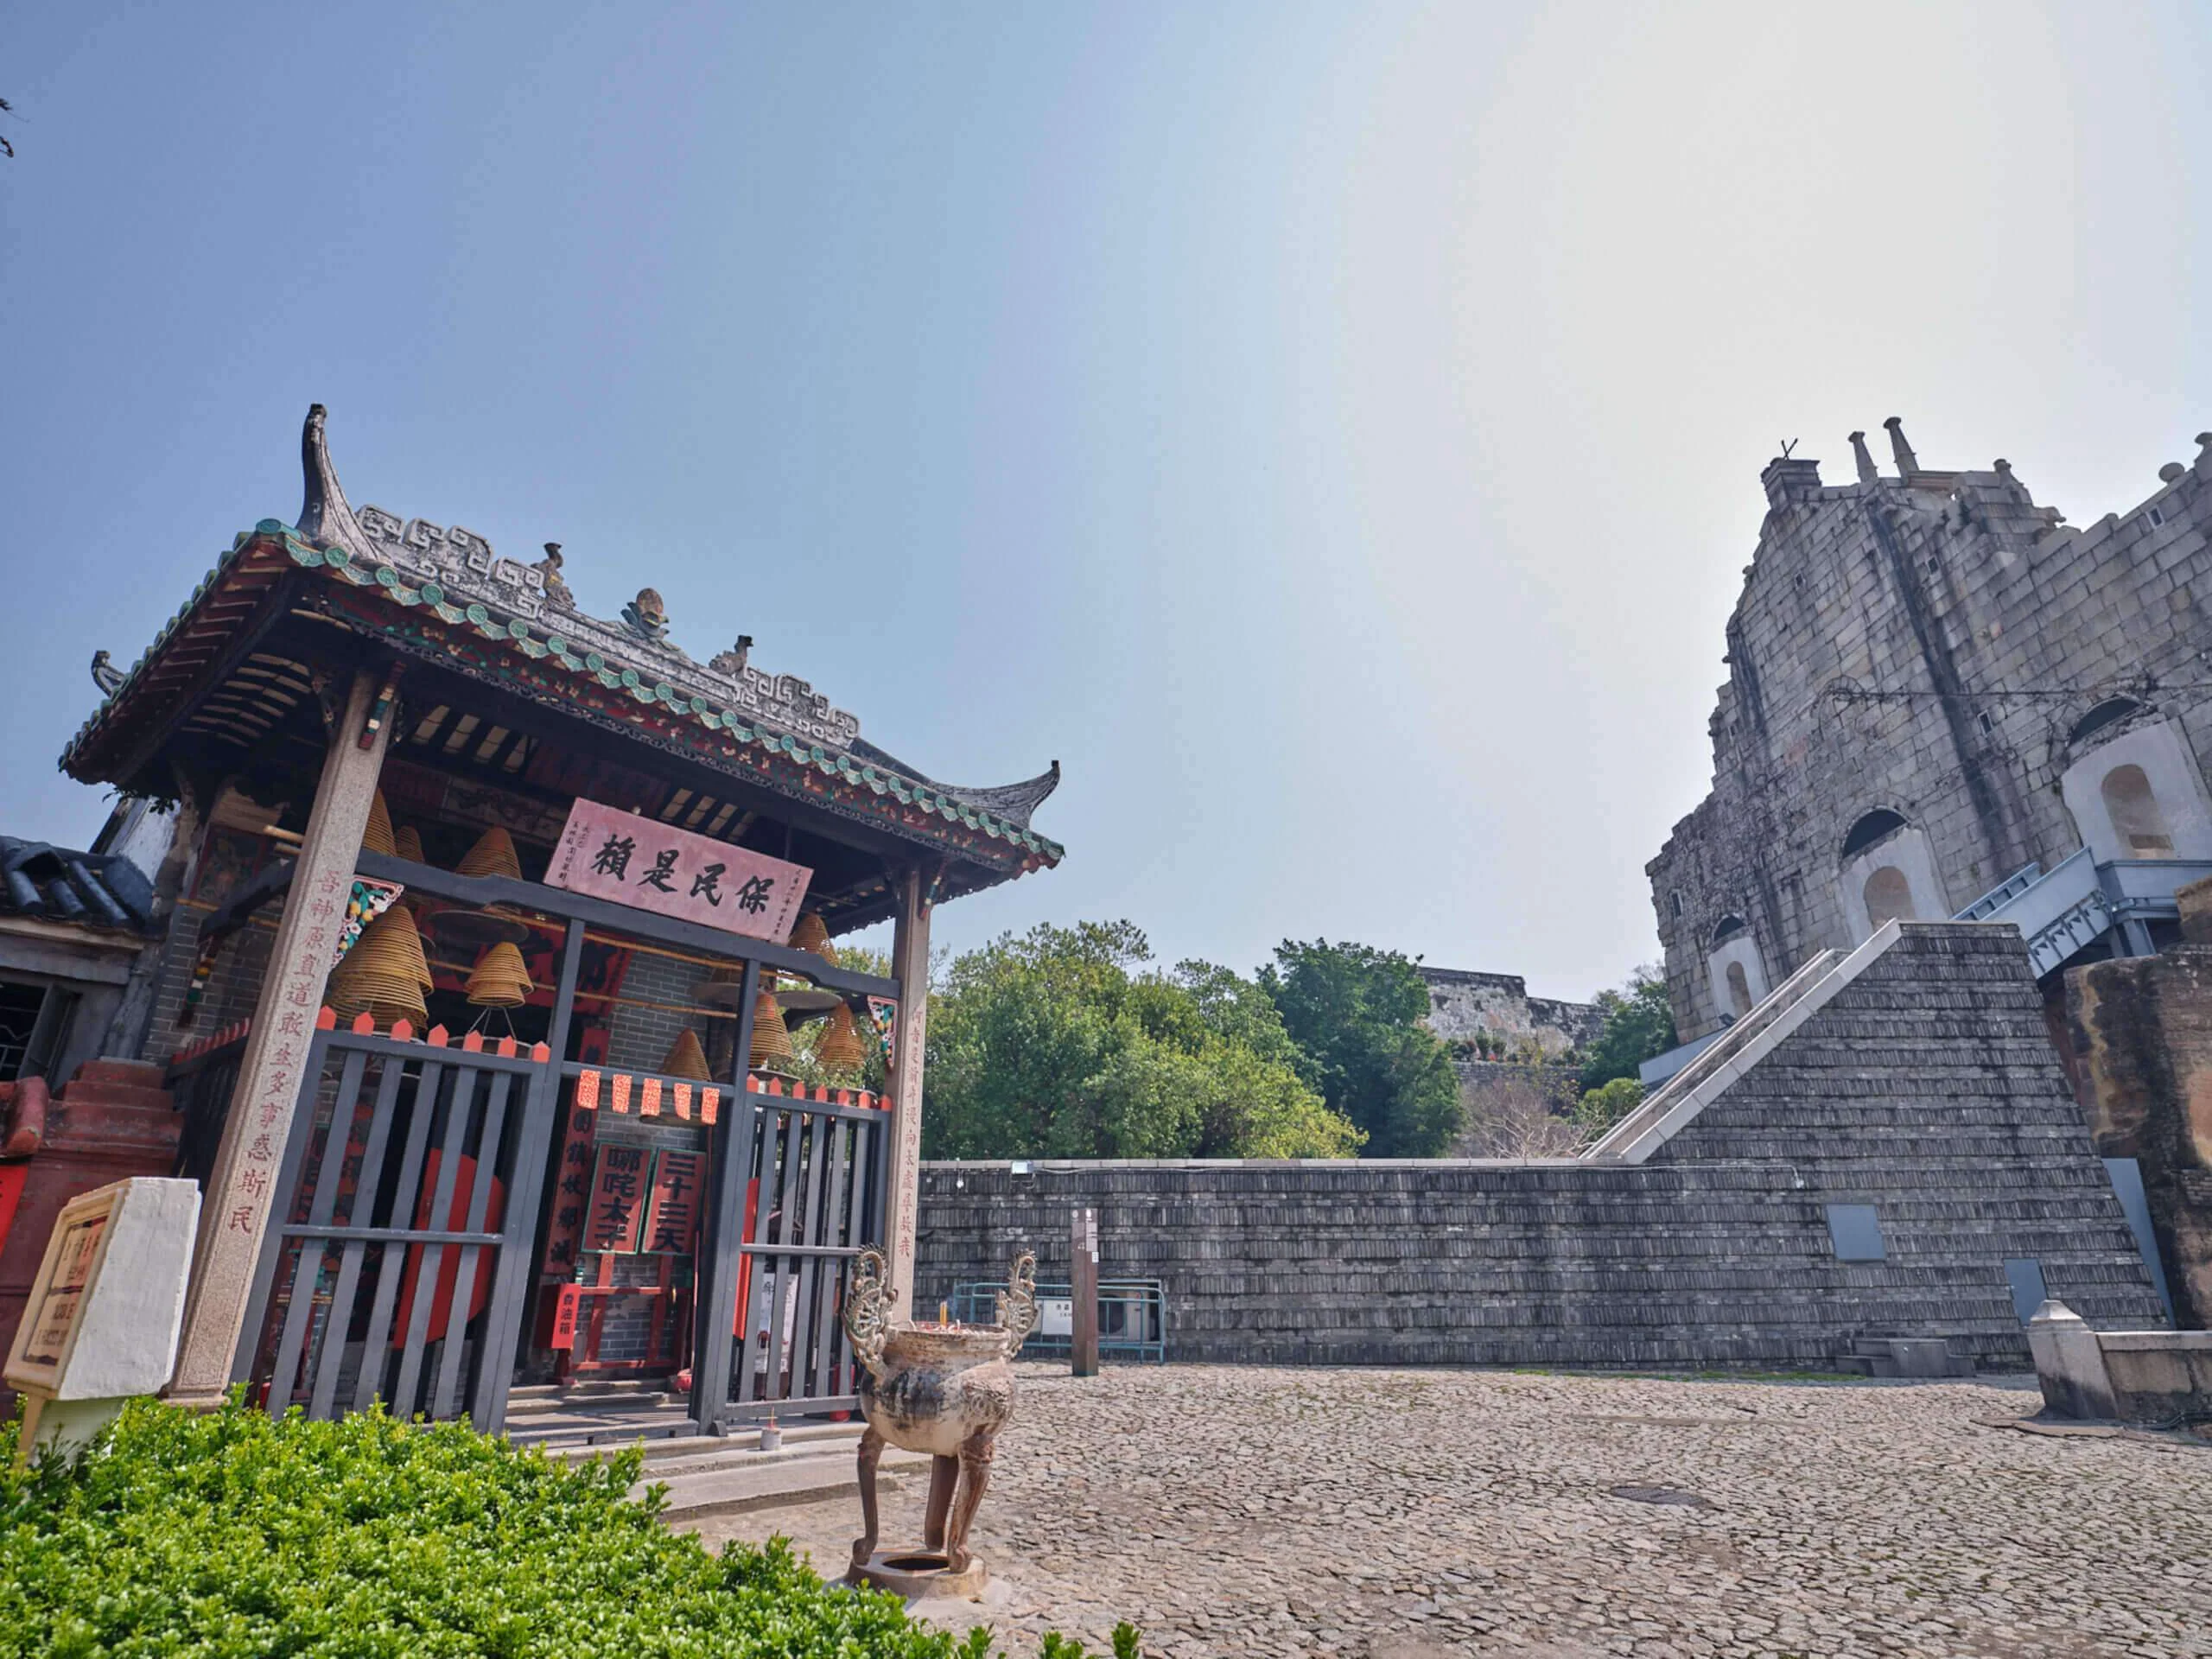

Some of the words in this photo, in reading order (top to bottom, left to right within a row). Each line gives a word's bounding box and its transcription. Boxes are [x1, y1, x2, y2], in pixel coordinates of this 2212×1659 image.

[656, 1153, 696, 1251] 三十三天
[559, 1293, 575, 1335] 香油箱
